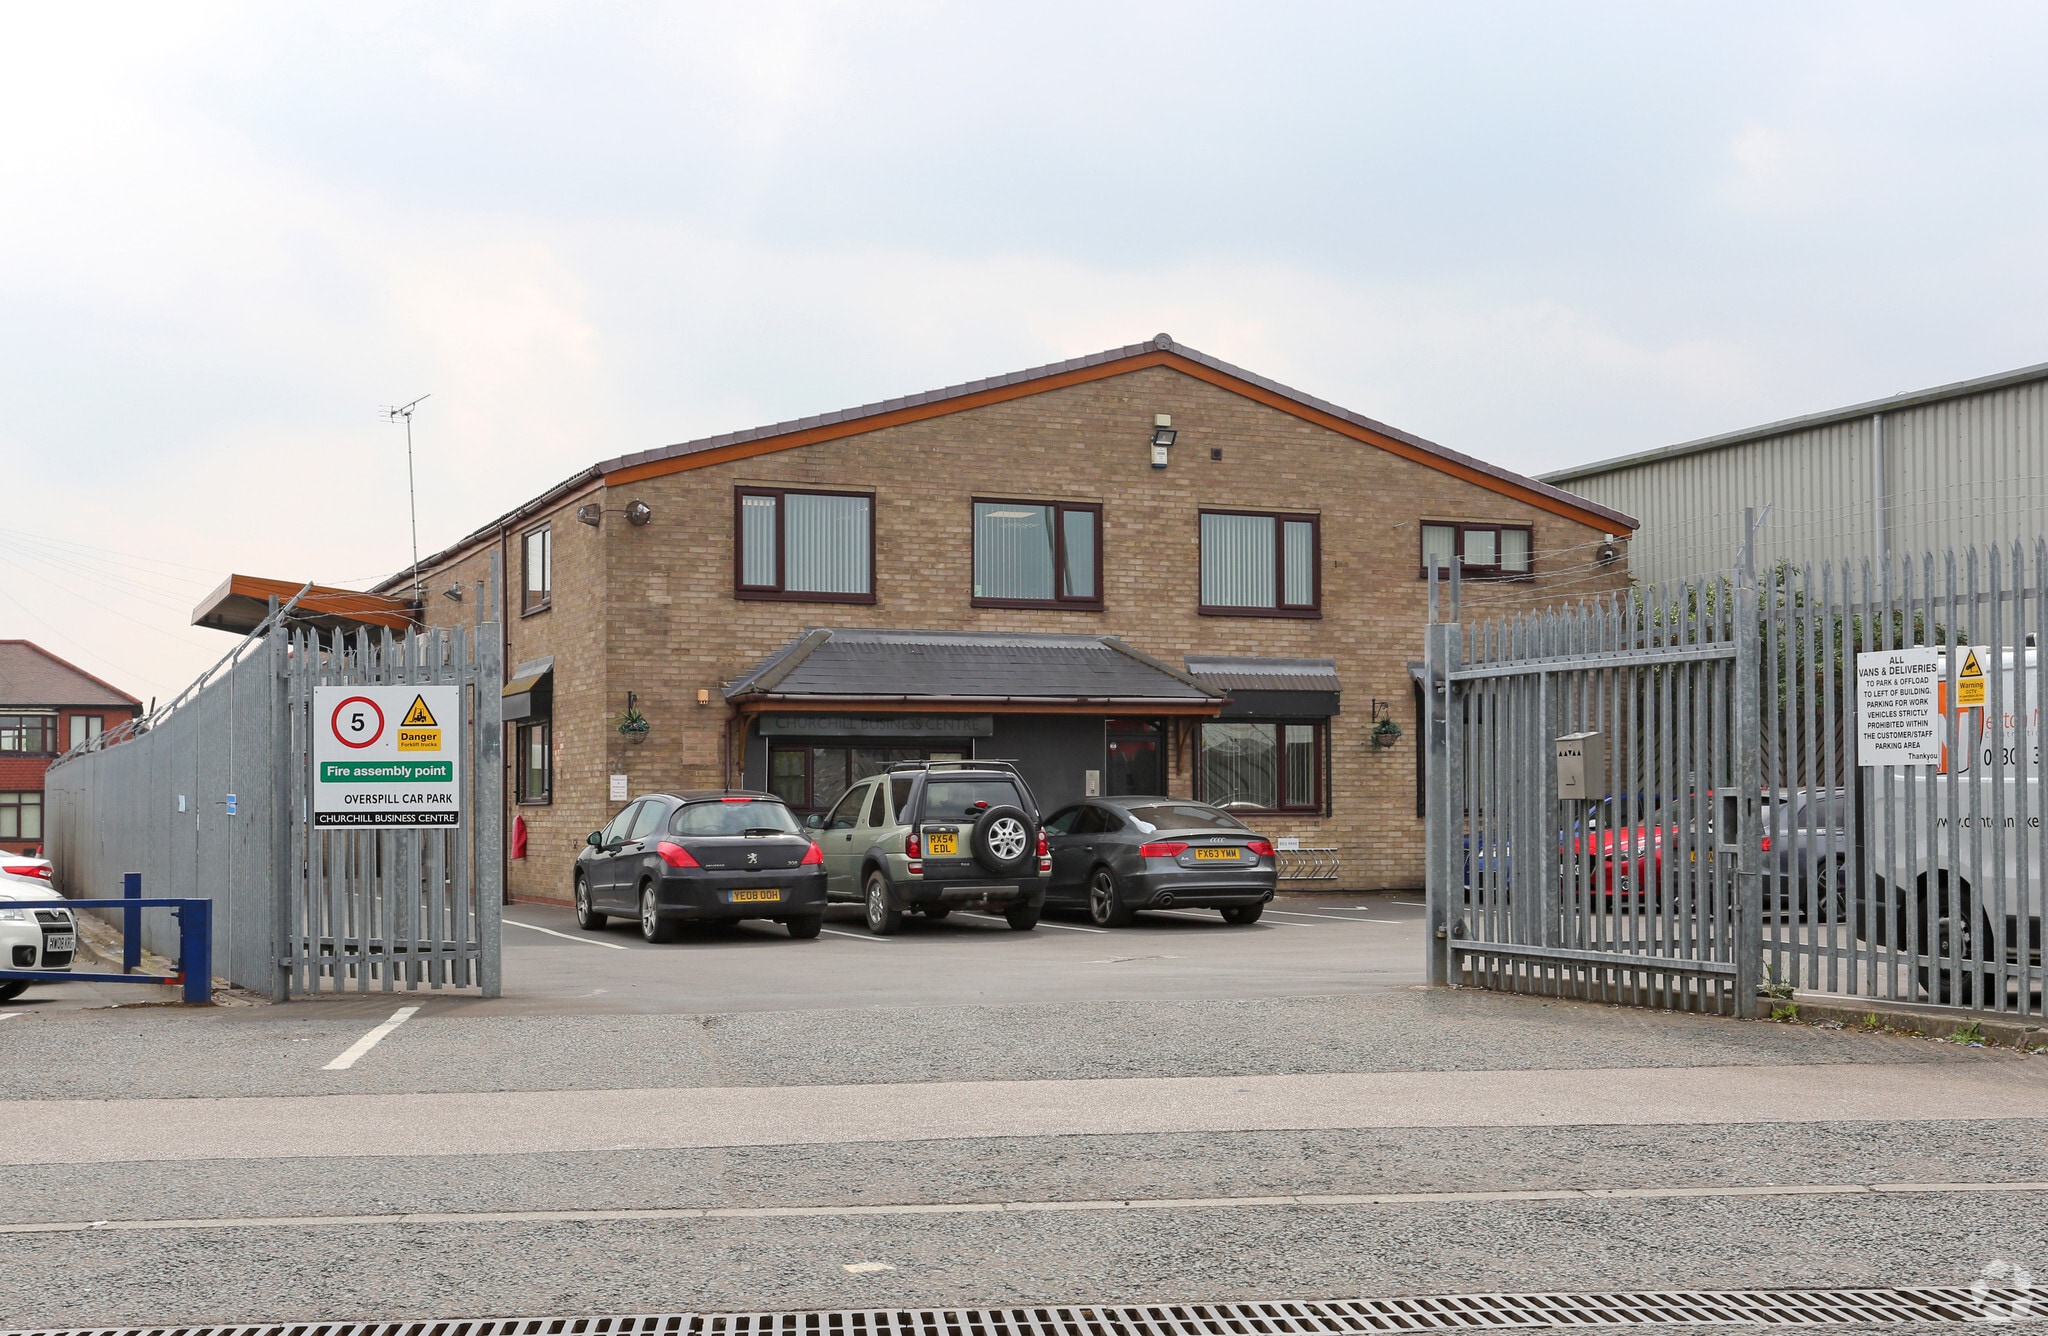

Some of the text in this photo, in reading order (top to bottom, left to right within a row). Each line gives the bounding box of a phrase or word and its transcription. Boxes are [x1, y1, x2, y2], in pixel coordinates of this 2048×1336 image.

[1889, 656, 1904, 665] ALL
[1859, 664, 1937, 677] VANS & DELIVERIES
[1960, 681, 1984, 689] Warning
[1900, 687, 1932, 695] BUILDING.
[1909, 698, 1928, 706] WORK
[351, 713, 365, 731] 5
[775, 717, 979, 731] CHURCHILL BUSINESS CENTRE
[1868, 721, 1904, 729] PROHIBITED
[401, 733, 437, 742] Danger
[1877, 731, 1933, 739] CUSTOMER/STAFF
[327, 765, 446, 778] Fire assembly point
[344, 794, 453, 804] OVERSPILL CAR PARK
[320, 814, 455, 823] CHURCHILL BUSINESS CENTRE
[930, 835, 953, 843] RX54
[934, 845, 951, 853] EDL
[1198, 850, 1237, 858] FX63 YMM
[734, 890, 757, 900] YE08
